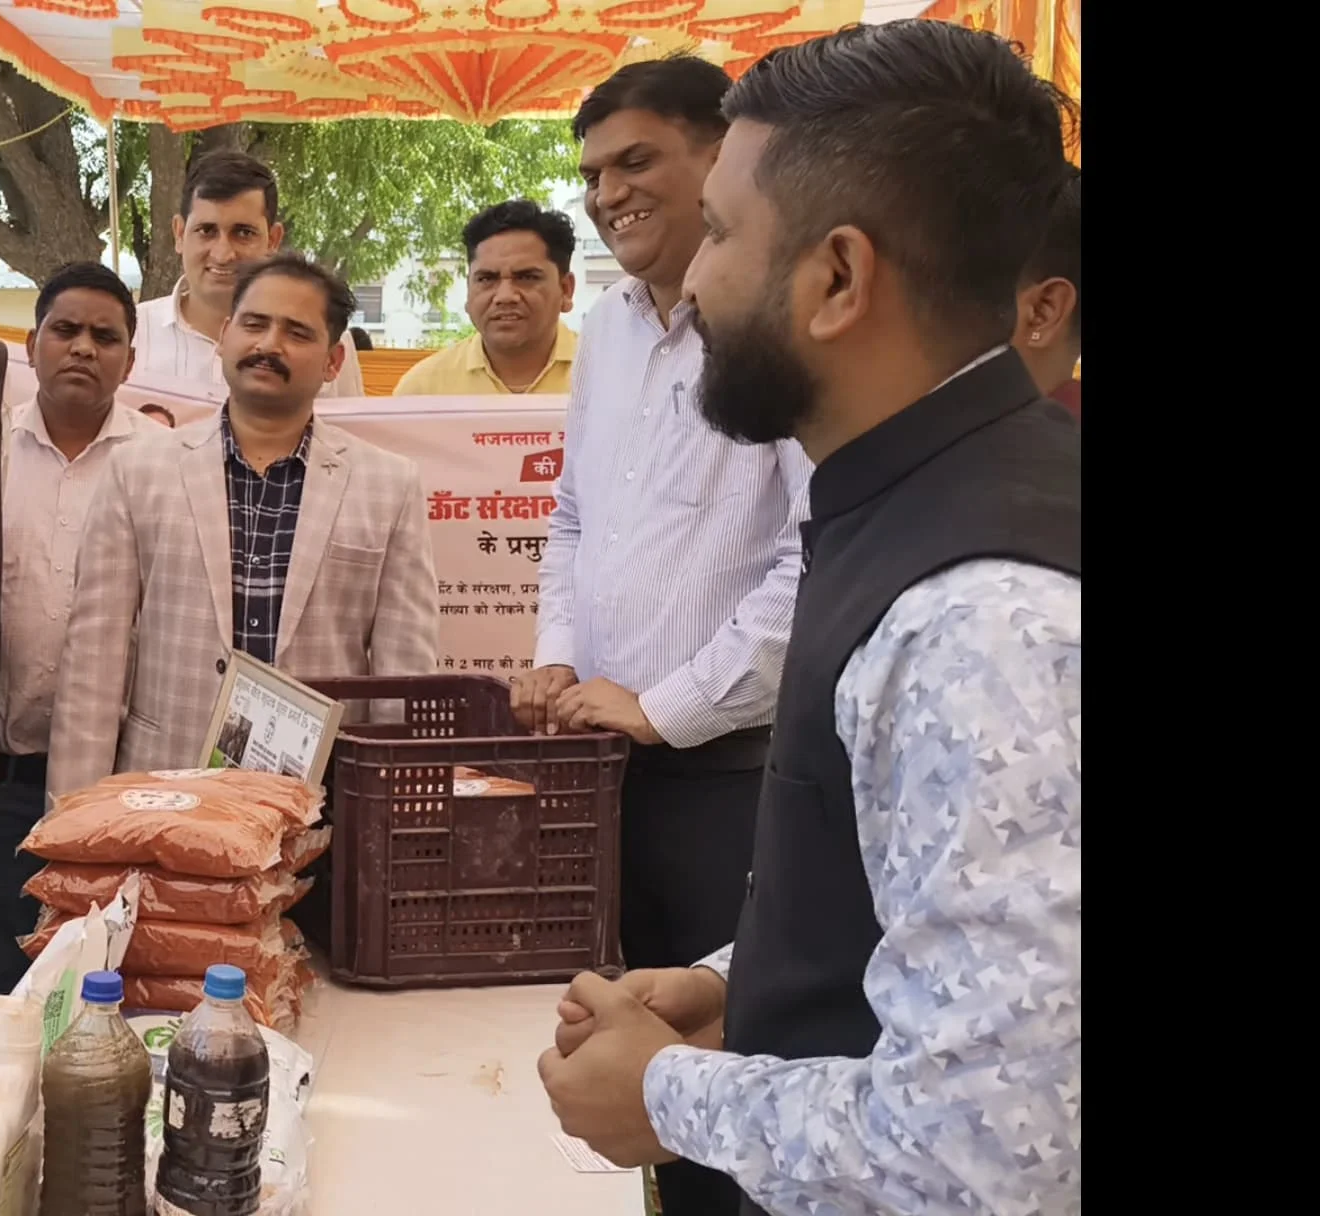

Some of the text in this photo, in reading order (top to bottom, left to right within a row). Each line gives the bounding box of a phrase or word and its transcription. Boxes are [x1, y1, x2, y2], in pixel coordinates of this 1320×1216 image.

[472, 431, 552, 446] भजनलाल
[532, 456, 556, 475] की
[427, 490, 472, 520] ऊँट
[477, 530, 498, 554] के
[456, 581, 469, 594] के
[473, 601, 489, 615] को
[493, 602, 525, 615] रोकने
[444, 655, 455, 670] से
[459, 659, 468, 670] 2
[473, 658, 495, 671] माह
[498, 654, 514, 669] की
